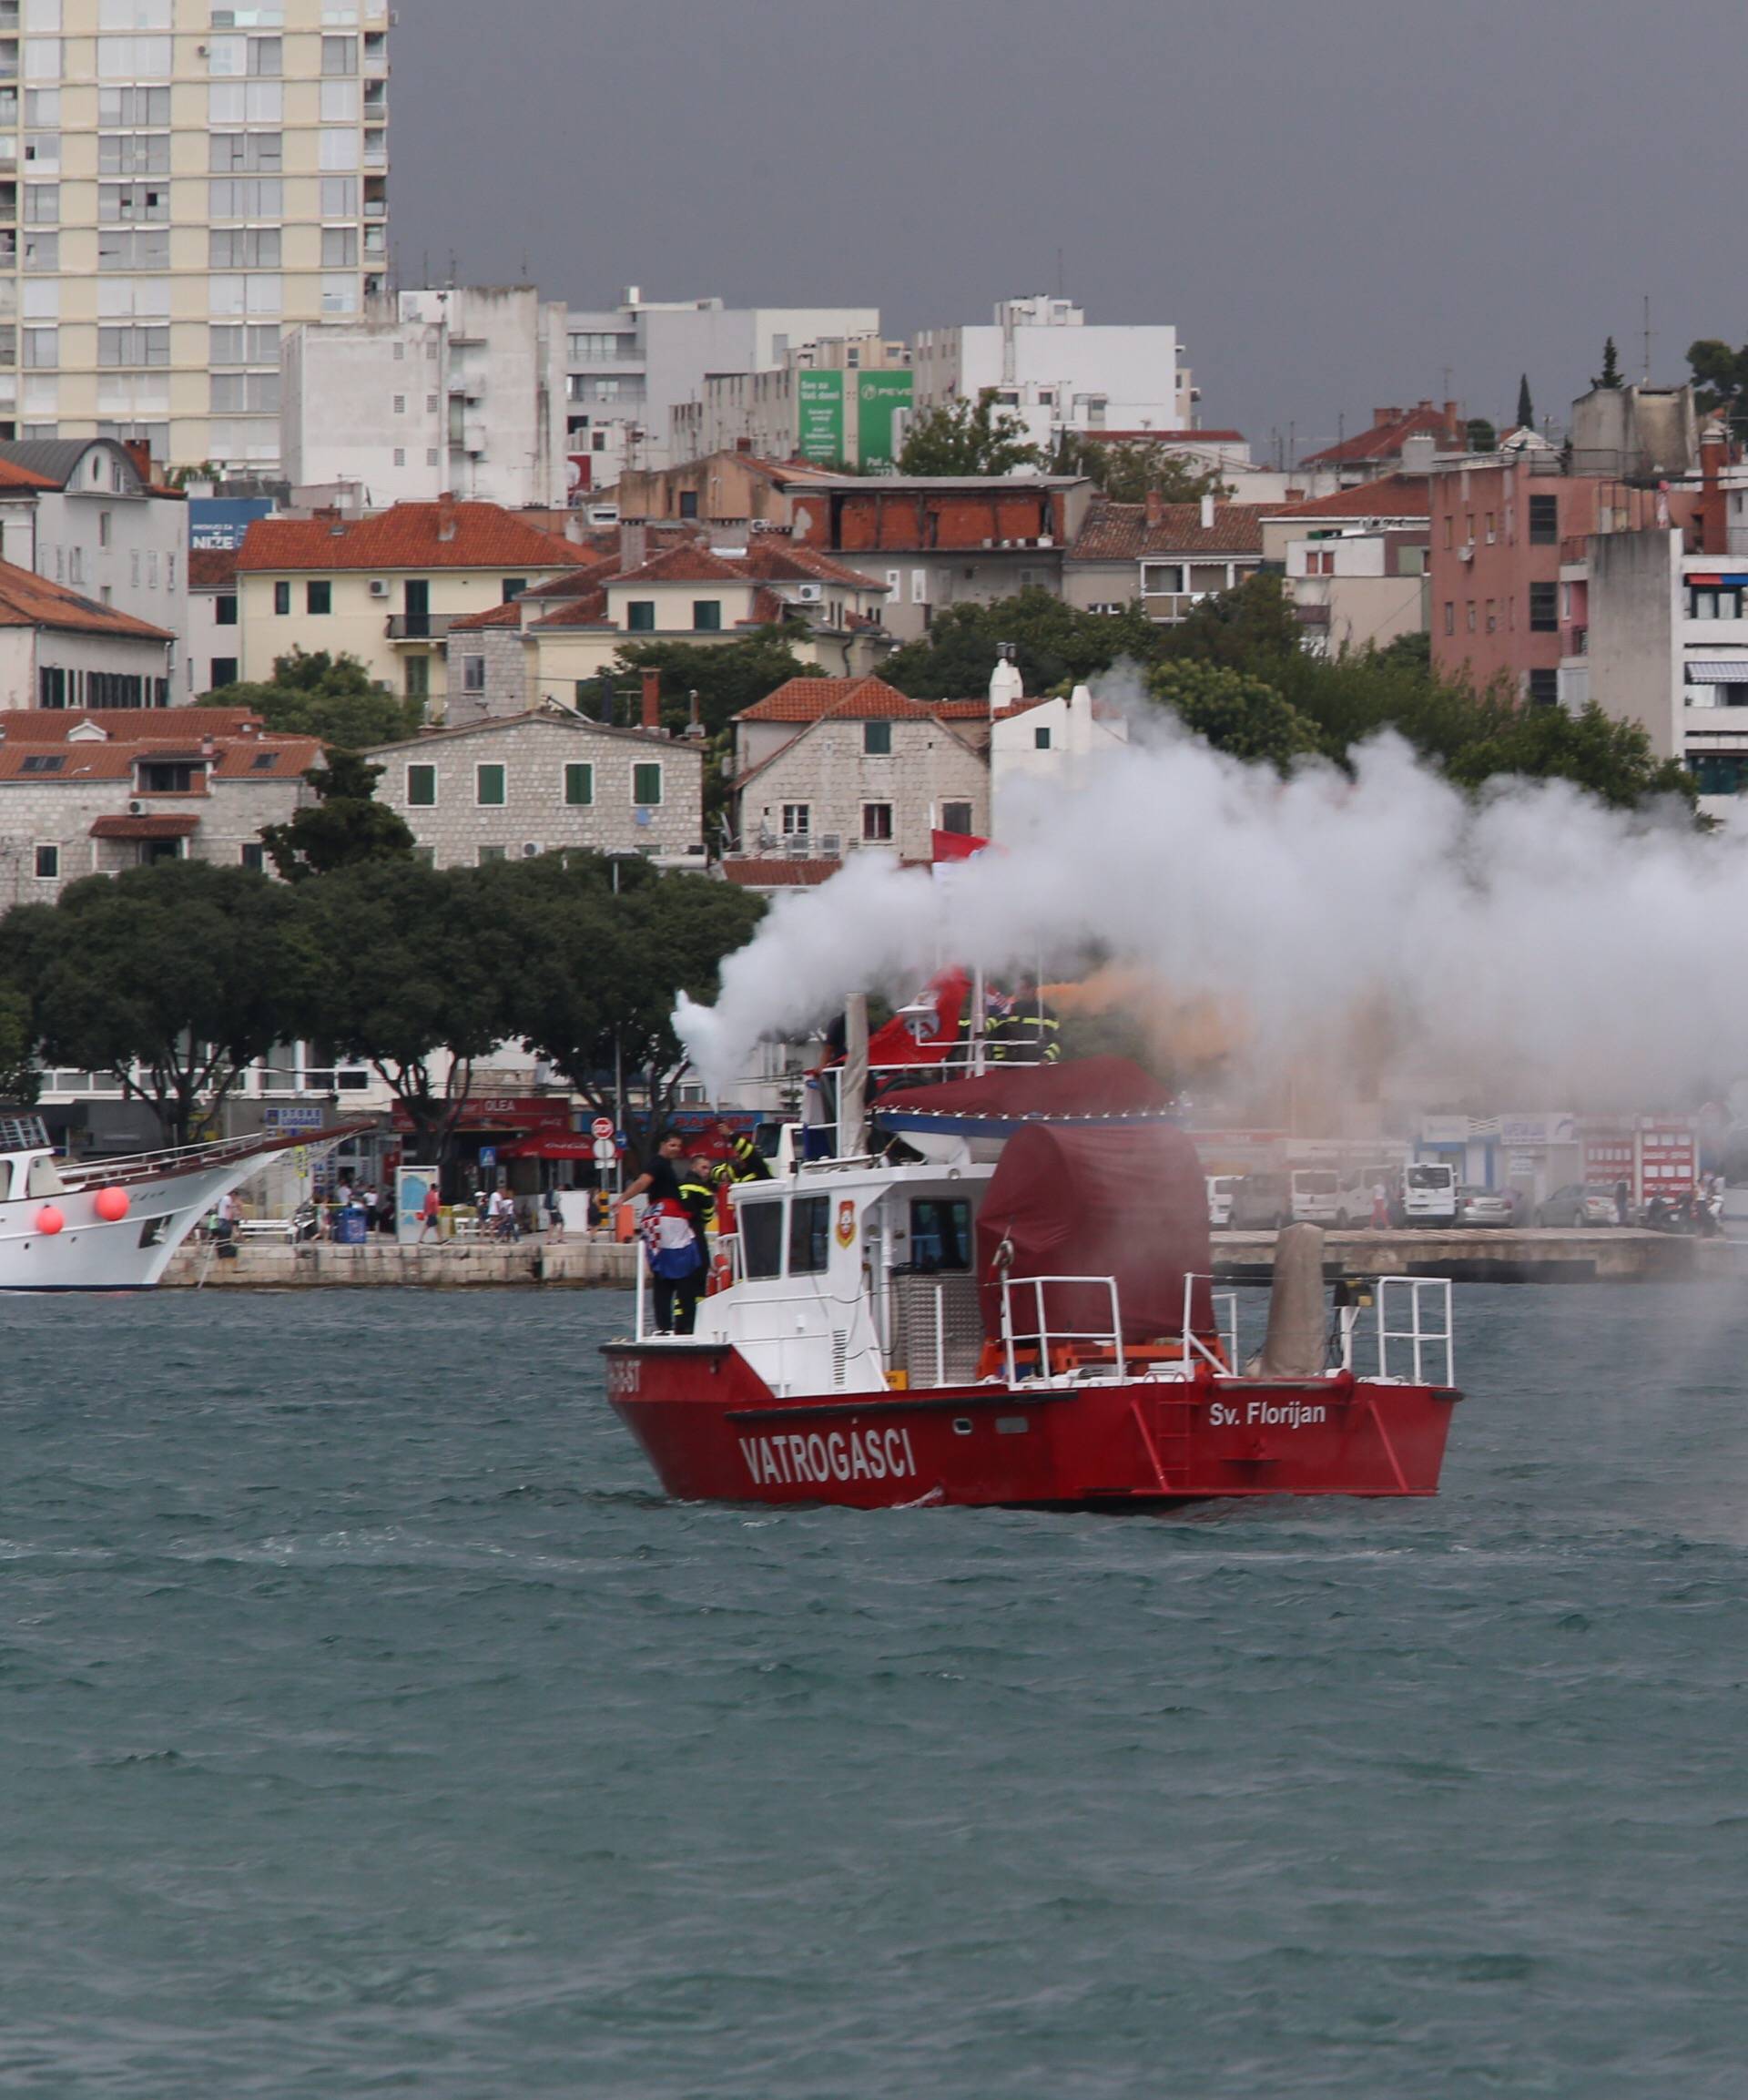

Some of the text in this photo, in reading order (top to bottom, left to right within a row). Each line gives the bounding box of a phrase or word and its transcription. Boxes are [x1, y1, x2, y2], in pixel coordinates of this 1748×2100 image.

[192, 531, 233, 549] NIŽE
[484, 1099, 515, 1112] OLEA
[281, 1109, 320, 1117] STORE
[281, 1117, 320, 1126] LUGGAGE
[1209, 1401, 1326, 1429] Sv. Florijan
